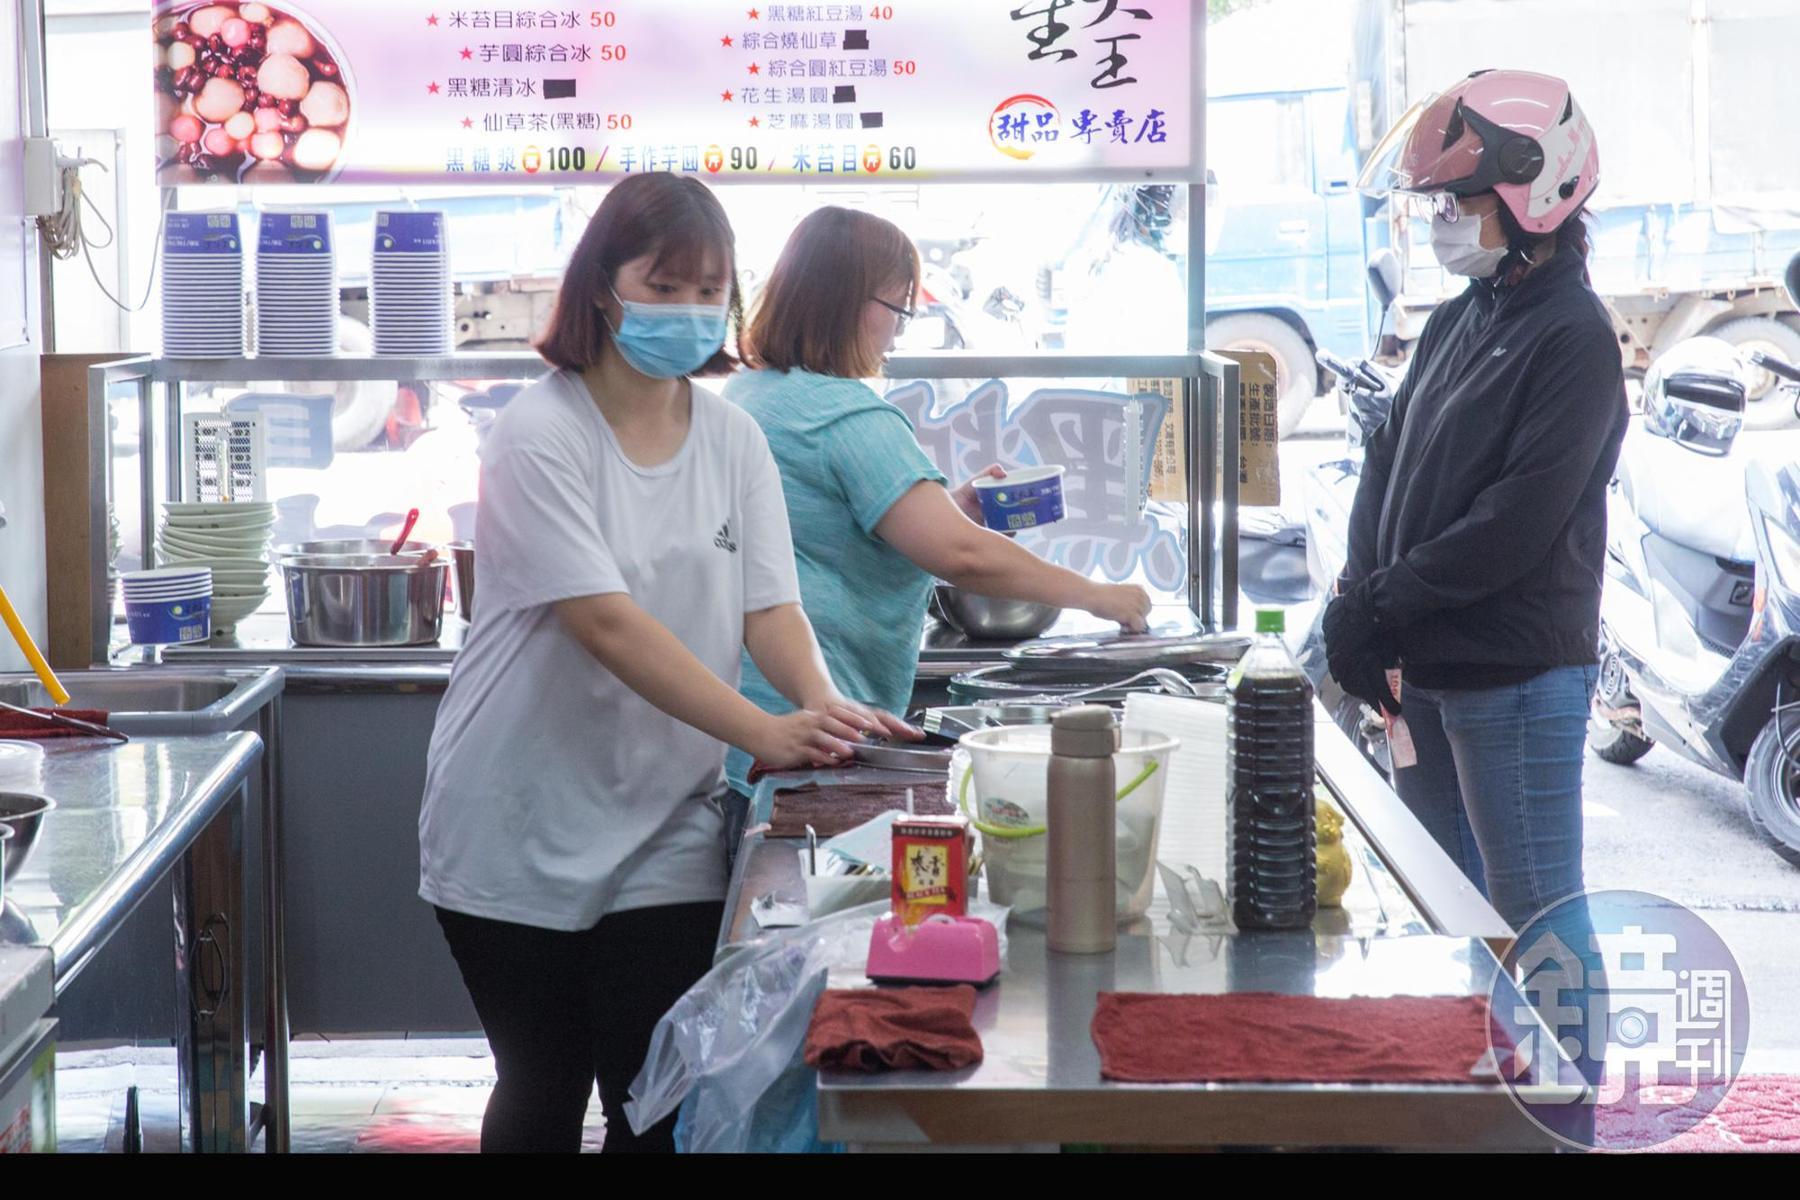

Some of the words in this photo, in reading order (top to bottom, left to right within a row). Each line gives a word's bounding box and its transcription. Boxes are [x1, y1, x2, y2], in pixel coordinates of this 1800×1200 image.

[449, 10, 581, 29] 米苔目綜合冰
[590, 11, 616, 27] 50
[768, 5, 863, 22] 黑糖紅豆湯
[869, 6, 893, 20] 40
[742, 32, 837, 50] 綜合燒仙草
[479, 44, 591, 63] 芋圓綜合冰
[601, 45, 626, 61] 50
[768, 59, 887, 78] 綜合圓紅豆湯
[893, 60, 916, 76] 50
[448, 77, 536, 98] 黑糖清冰
[741, 86, 828, 104] 花生湯圓
[483, 112, 601, 132] 仙草茶(黑糖)
[607, 114, 632, 130] 50
[767, 113, 854, 130] 芝麻湯圓
[547, 146, 586, 171] 100
[730, 146, 758, 171] 90
[792, 145, 857, 172] 米苔目
[889, 146, 916, 170] 60
